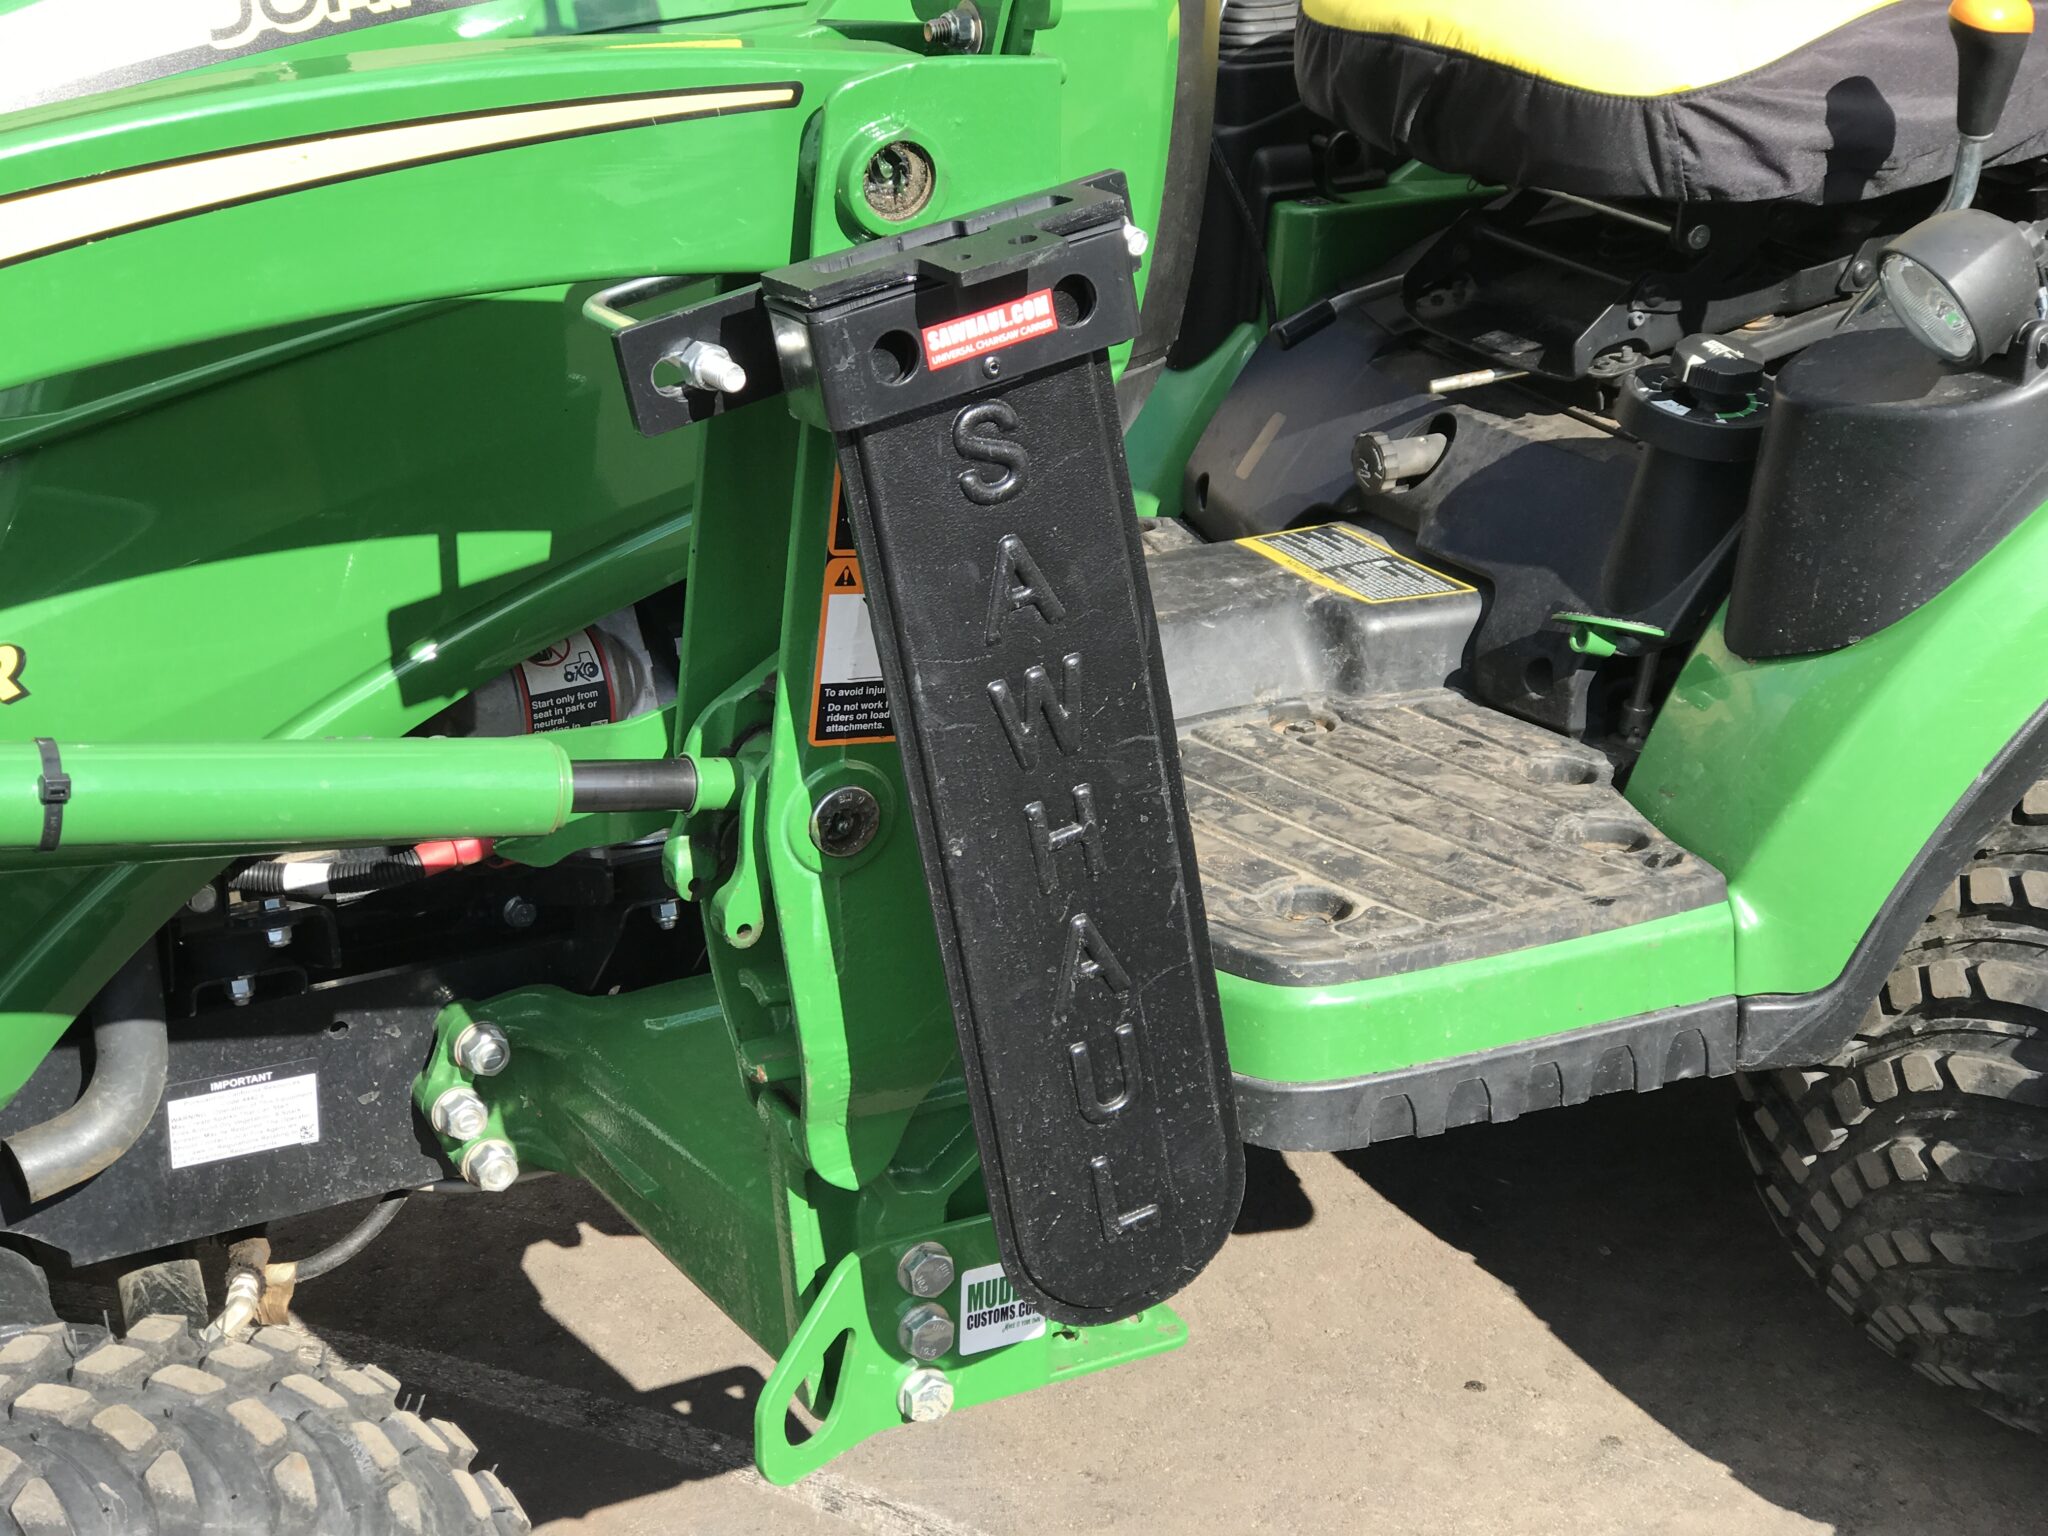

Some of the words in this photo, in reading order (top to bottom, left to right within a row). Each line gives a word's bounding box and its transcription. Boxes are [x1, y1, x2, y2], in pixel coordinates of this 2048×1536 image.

[927, 295, 1050, 351] SAWHAUL.COM
[932, 344, 976, 365] UNIVERSAL
[976, 329, 1019, 350] CHAINSAW
[1020, 318, 1054, 336] CARRIER
[531, 698, 554, 710] Start
[556, 694, 575, 705] only
[577, 690, 599, 700] from
[824, 688, 836, 697] To
[838, 686, 864, 697] avoid
[865, 685, 886, 697] inju
[533, 709, 552, 720] seat
[554, 707, 563, 716] in
[565, 702, 586, 715] park
[587, 700, 598, 709] or
[826, 713, 854, 722] riders
[856, 712, 868, 720] on
[870, 710, 891, 720] load
[827, 703, 841, 712] Do
[843, 702, 859, 712] not
[860, 700, 884, 710] work
[533, 716, 568, 730] neutral.
[825, 721, 885, 733] attachments.
[953, 401, 1163, 1243] SAWHAUL
[210, 1071, 273, 1092] IMPORTANT
